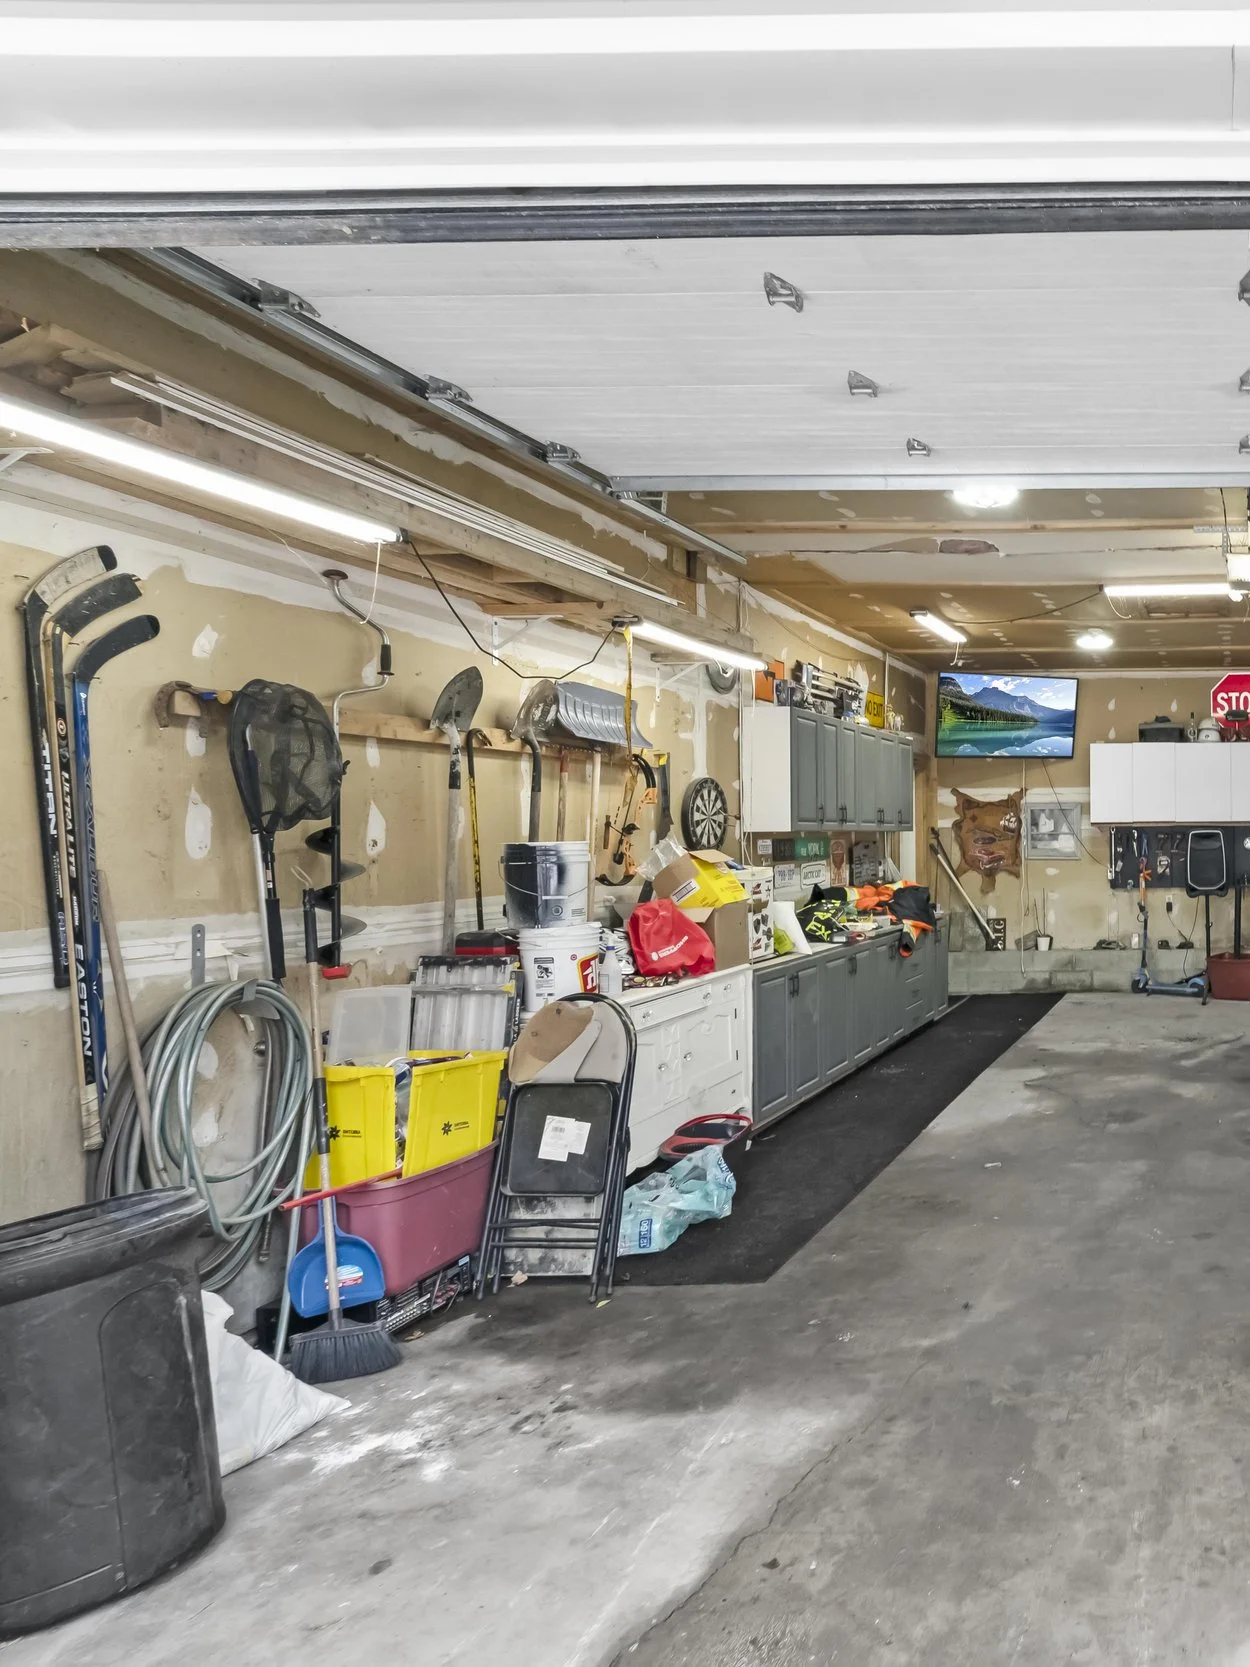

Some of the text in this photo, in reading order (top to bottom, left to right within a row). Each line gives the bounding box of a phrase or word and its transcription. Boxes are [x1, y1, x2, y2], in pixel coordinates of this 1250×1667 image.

[42, 742, 58, 835] TITAN
[61, 770, 77, 878] ULTRA LITE
[75, 943, 92, 1057] EASTON
